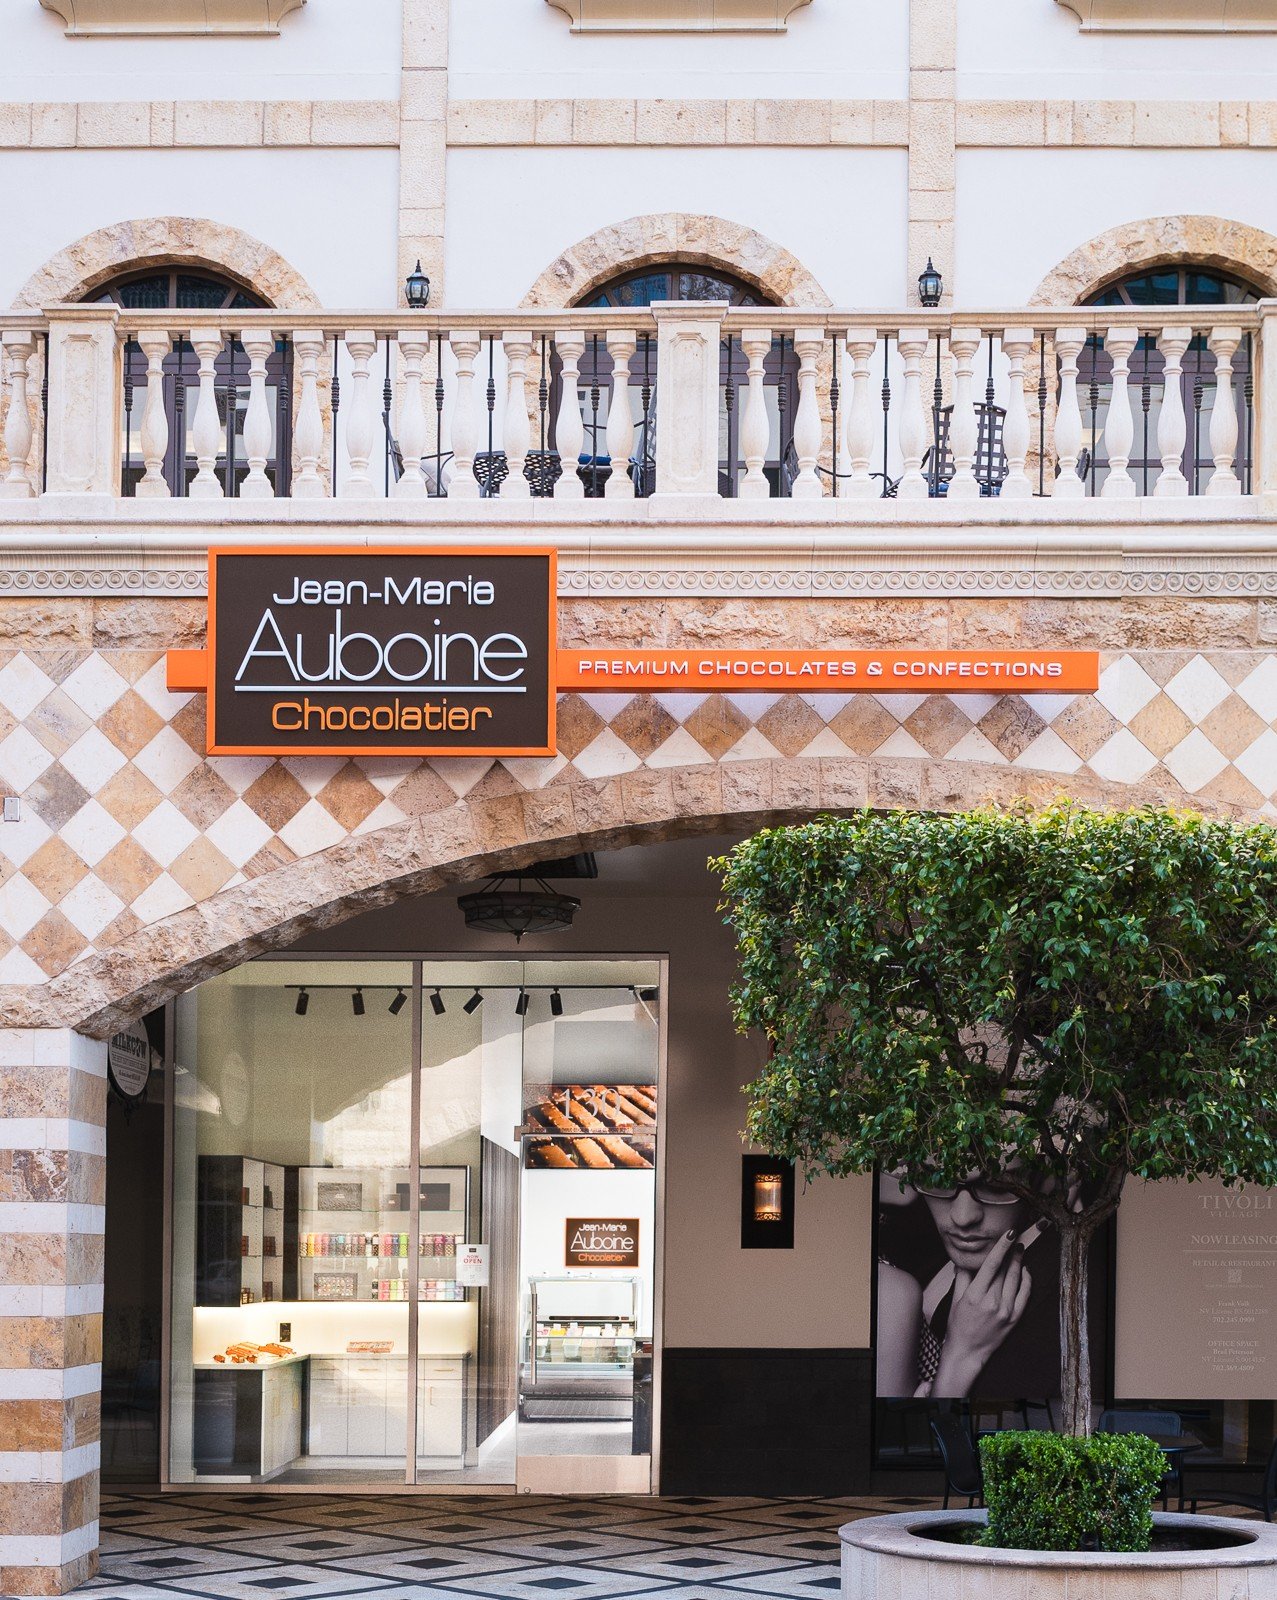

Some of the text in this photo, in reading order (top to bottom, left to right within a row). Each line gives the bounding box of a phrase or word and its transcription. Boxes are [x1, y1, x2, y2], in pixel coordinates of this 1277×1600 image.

[272, 574, 495, 605] Jean-Marie
[234, 607, 528, 682] Auboine
[578, 660, 1063, 677] PREMIUM CHOCOLATES & CONFECTIONS
[271, 698, 493, 731] Chocolatier
[560, 1088, 621, 1120] 130
[1197, 1195, 1273, 1210] TIVOLI
[1210, 1210, 1261, 1218] VILLAGE
[578, 1222, 627, 1232] Jean-Marie
[570, 1231, 634, 1250] Auboine
[1191, 1235, 1277, 1245] NOW LEASING
[578, 1252, 627, 1262] Chocolatier
